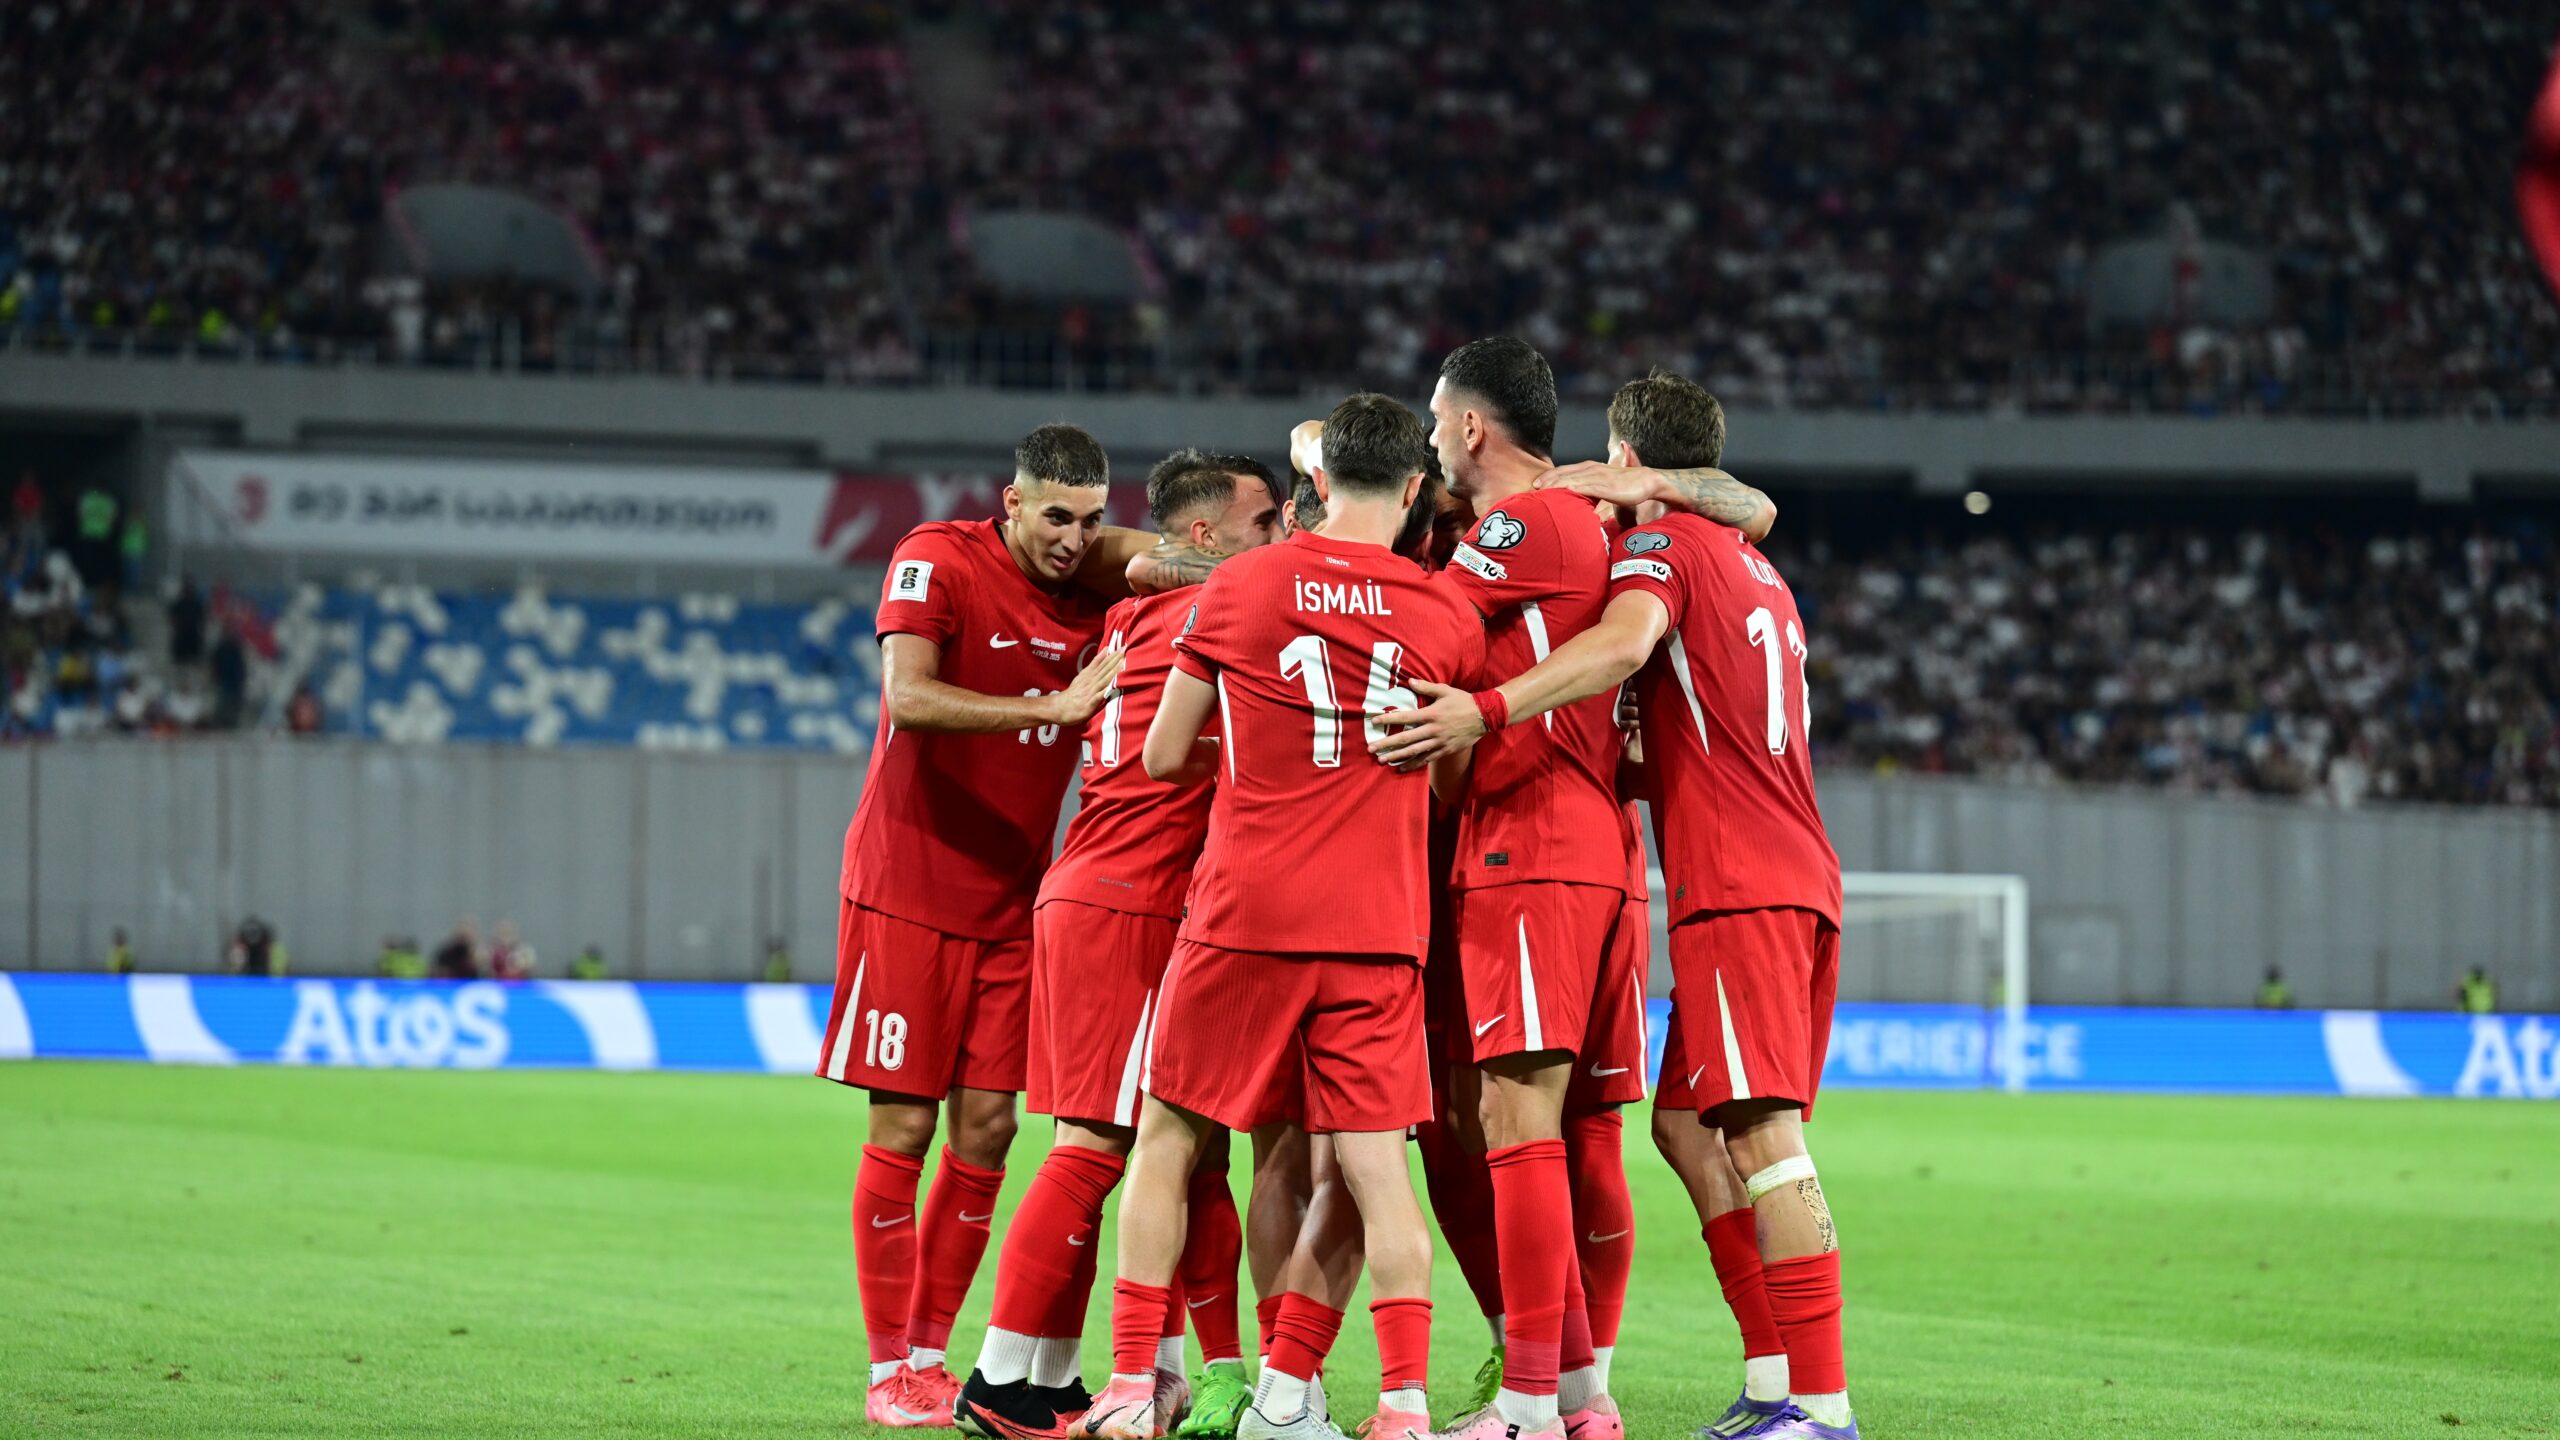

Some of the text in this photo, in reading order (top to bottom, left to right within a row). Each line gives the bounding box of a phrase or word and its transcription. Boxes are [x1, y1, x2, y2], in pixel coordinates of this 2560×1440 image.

[1295, 574, 1392, 615] İSMAİL
[866, 1009, 907, 1071] 18
[2453, 1014, 2560, 1098] At
